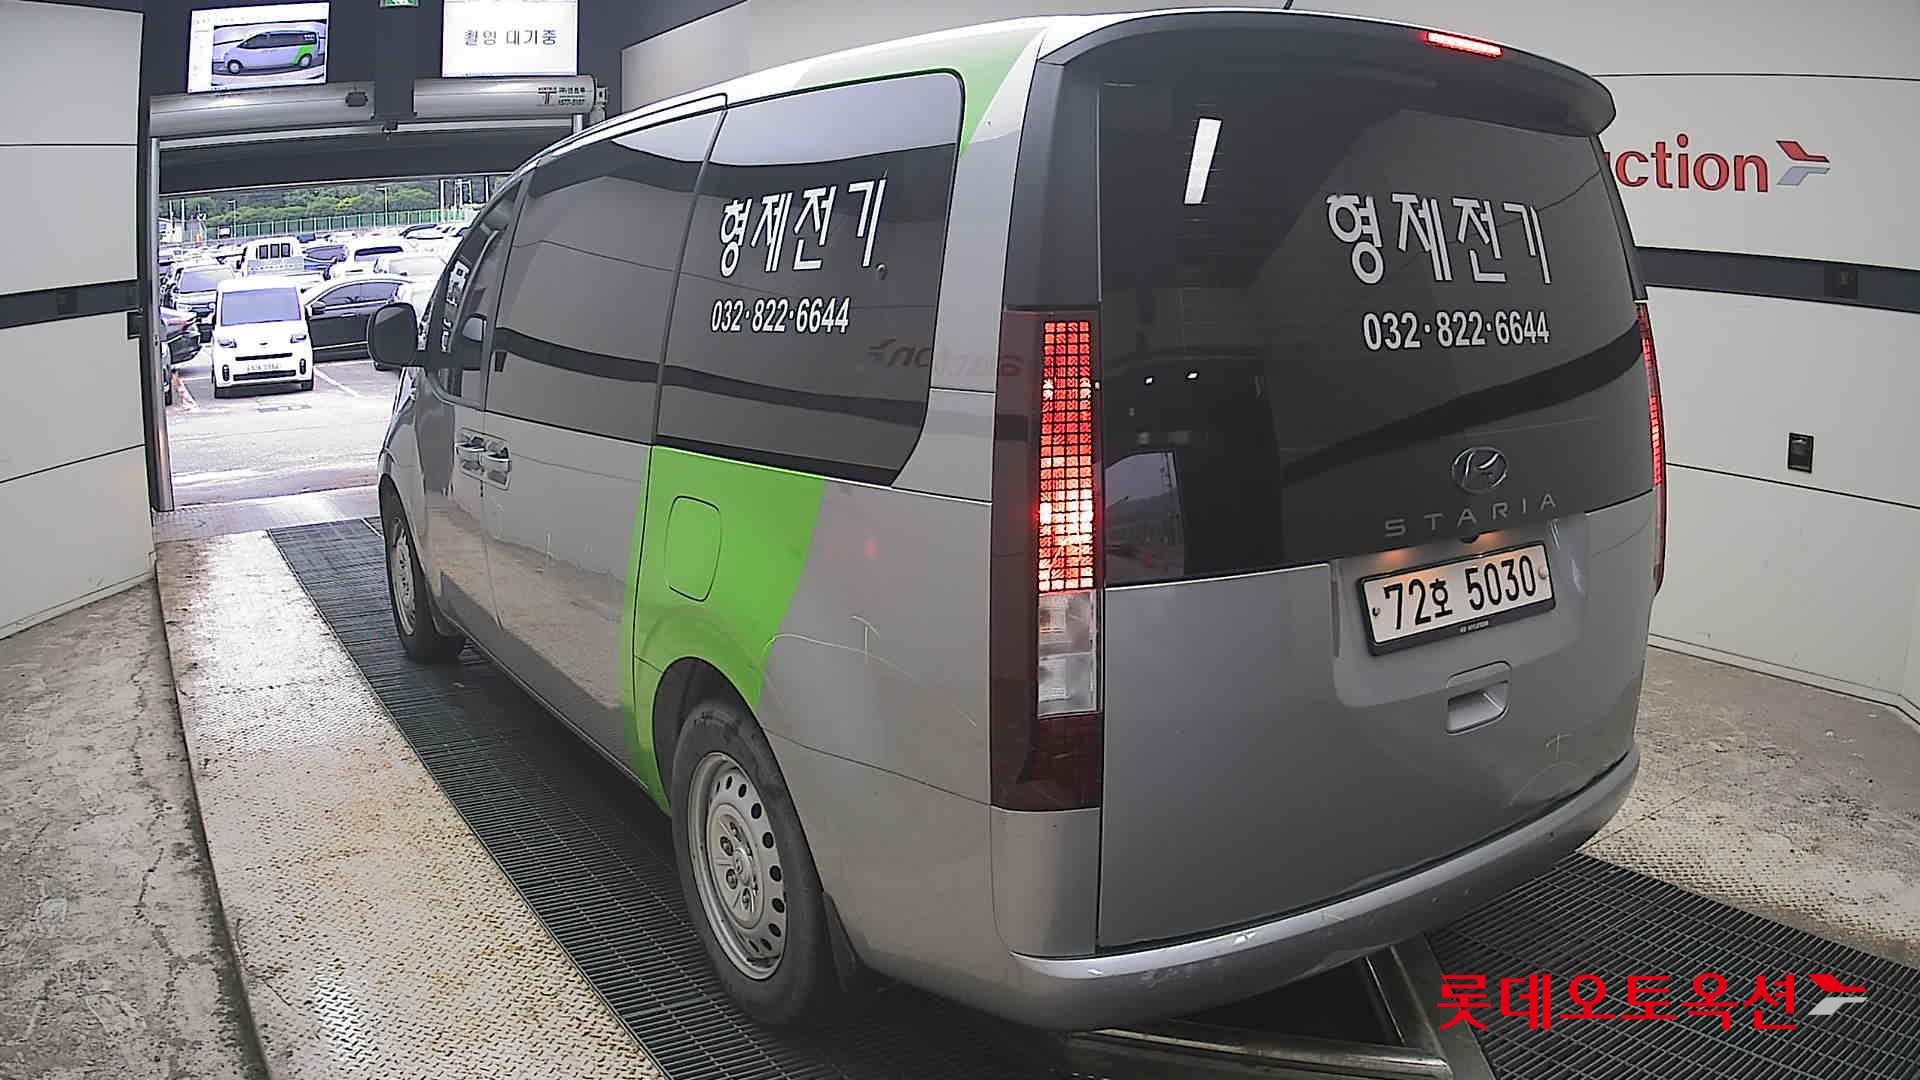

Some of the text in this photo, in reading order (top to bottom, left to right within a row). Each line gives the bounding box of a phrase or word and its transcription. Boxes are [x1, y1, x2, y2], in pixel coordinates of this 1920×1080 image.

[505, 29, 557, 46] 대기중
[1604, 133, 1769, 193] ction
[720, 178, 887, 278] 형제전기
[1326, 192, 1551, 284] 형제전기
[1384, 493, 1556, 537] STARIA
[1383, 554, 1537, 631] 72호 5030
